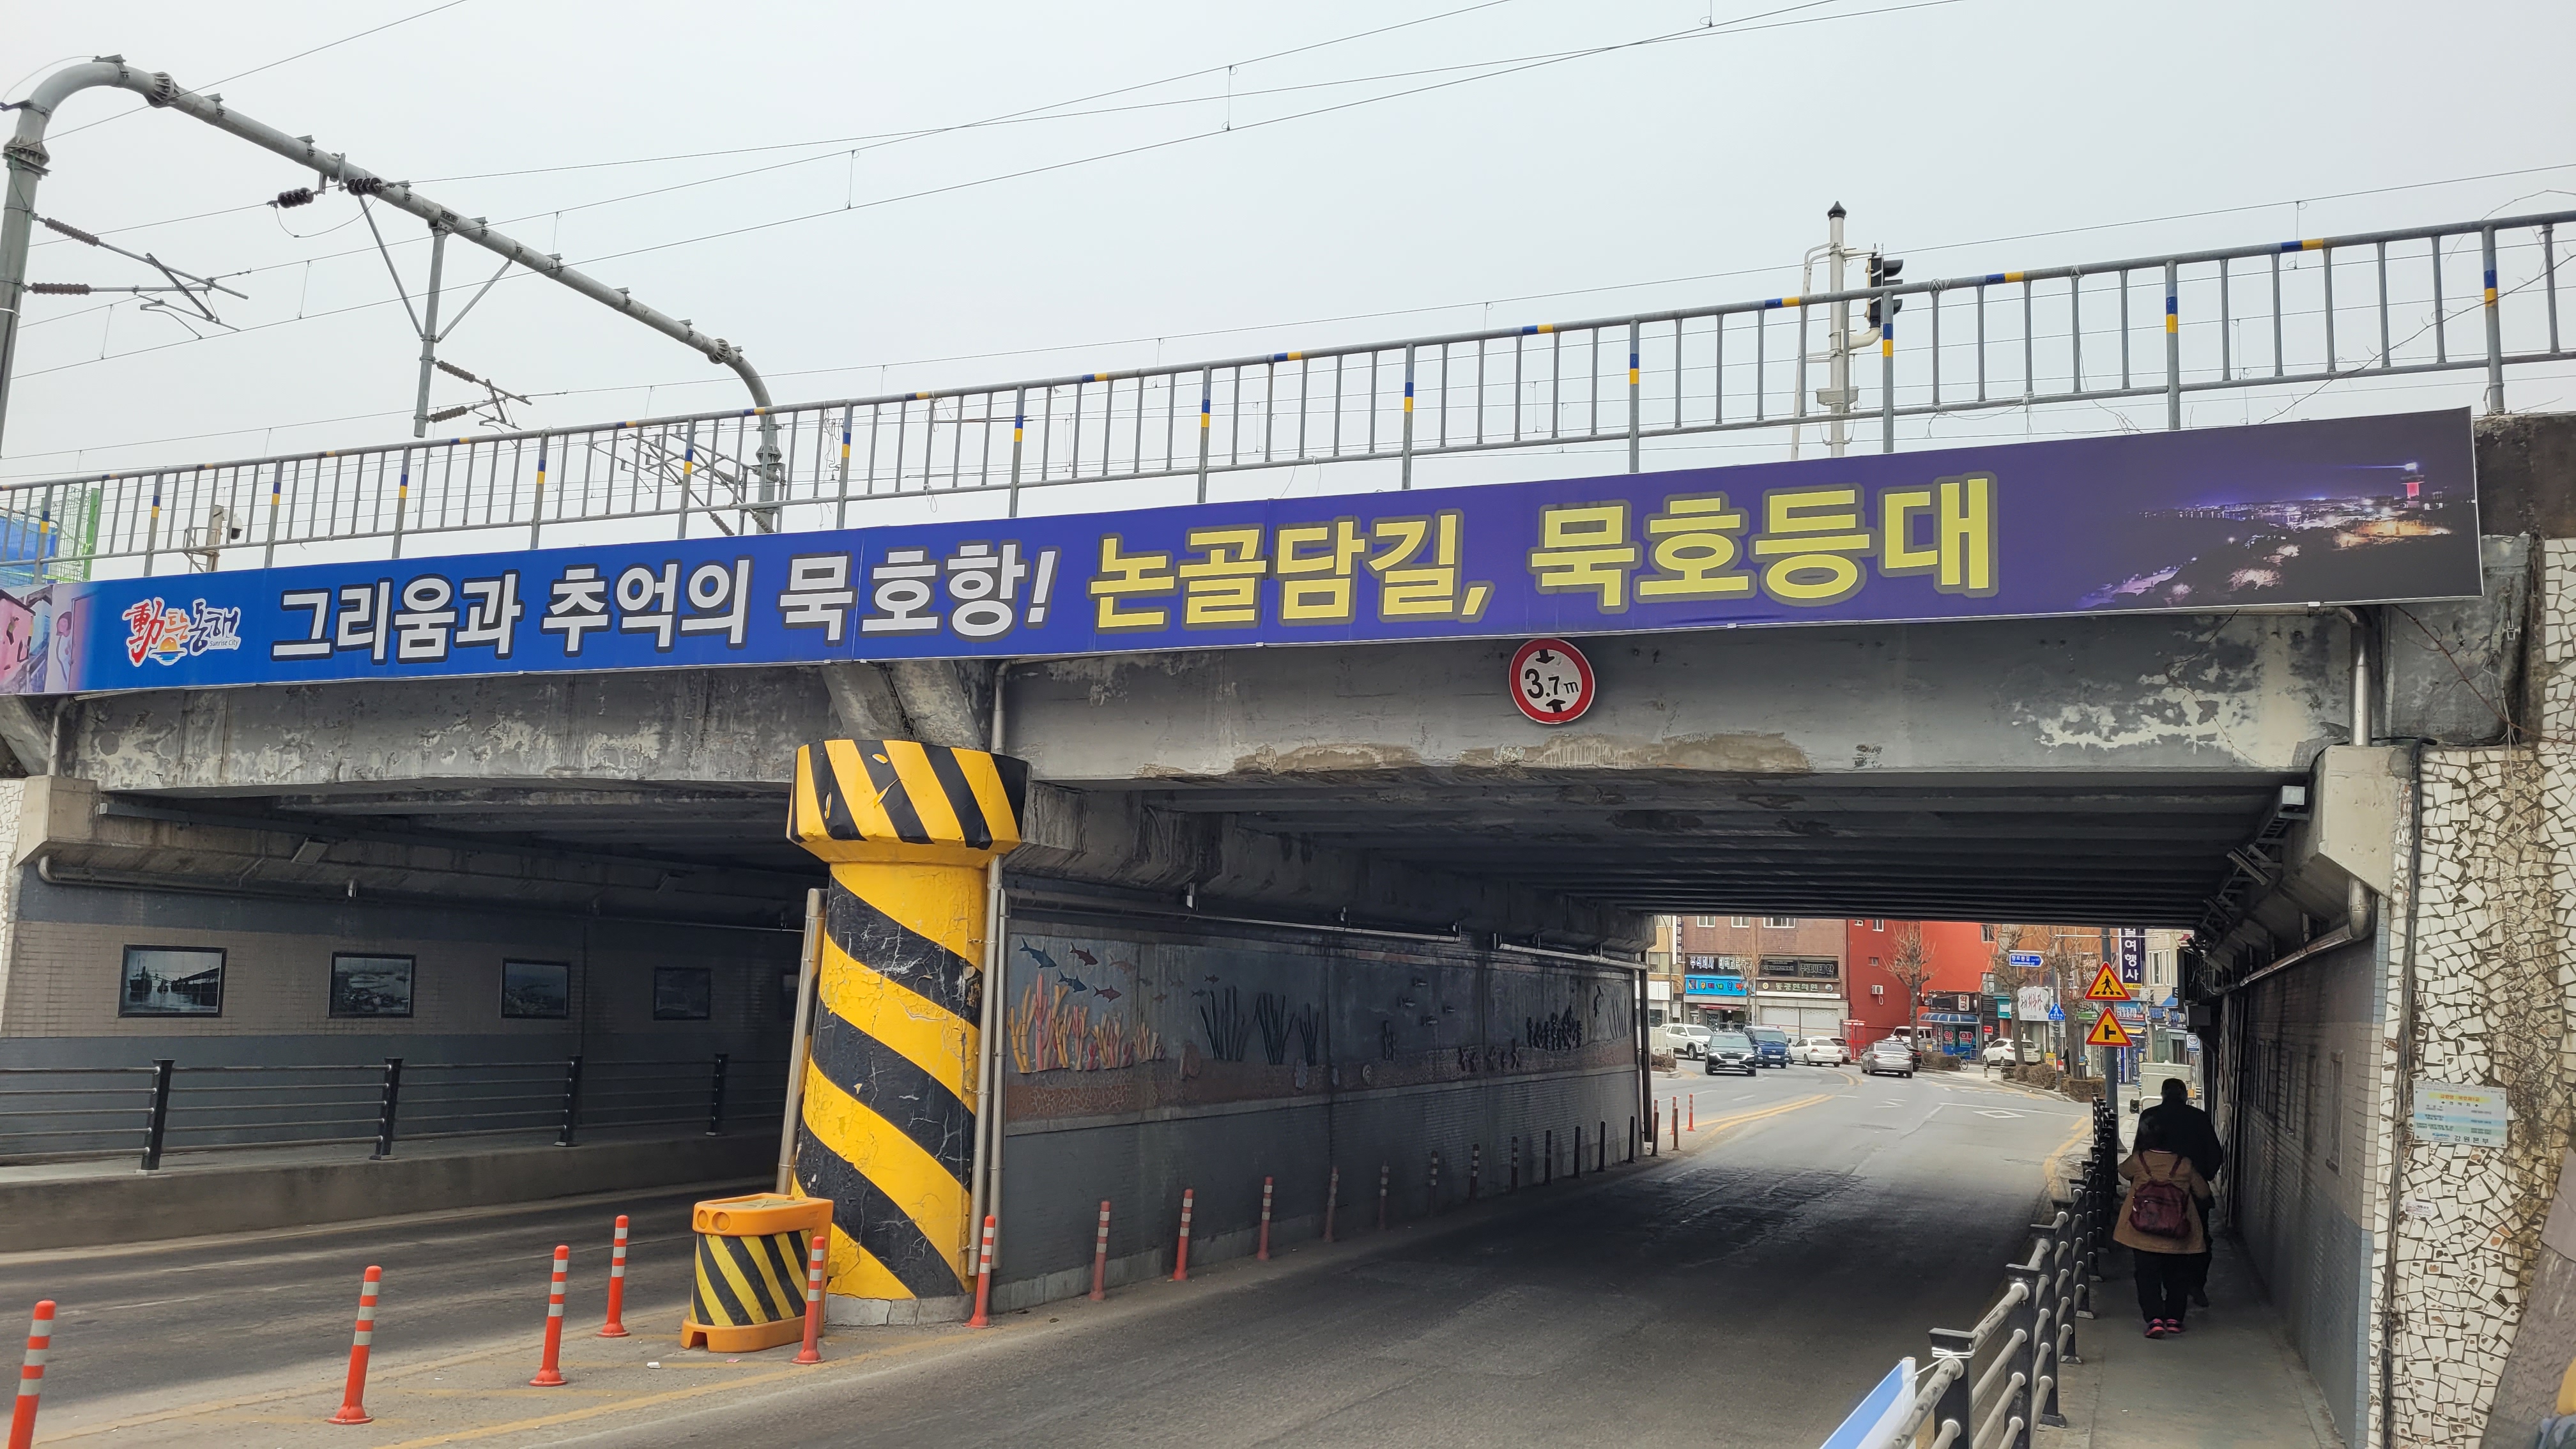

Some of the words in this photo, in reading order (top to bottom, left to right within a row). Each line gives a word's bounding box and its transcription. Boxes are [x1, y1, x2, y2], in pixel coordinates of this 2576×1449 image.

[272, 572, 521, 659] 그리움과
[544, 559, 751, 652] 추억의
[779, 544, 1056, 641] 묵호항!
[1091, 514, 1491, 628] 논골담길,
[1531, 478, 1991, 609] 묵호등대
[1690, 956, 1714, 970] 주식회사
[1944, 1031, 1953, 1043] 약
[1959, 1032, 1974, 1044] 약
[2454, 1135, 2489, 1145] 강원본부
